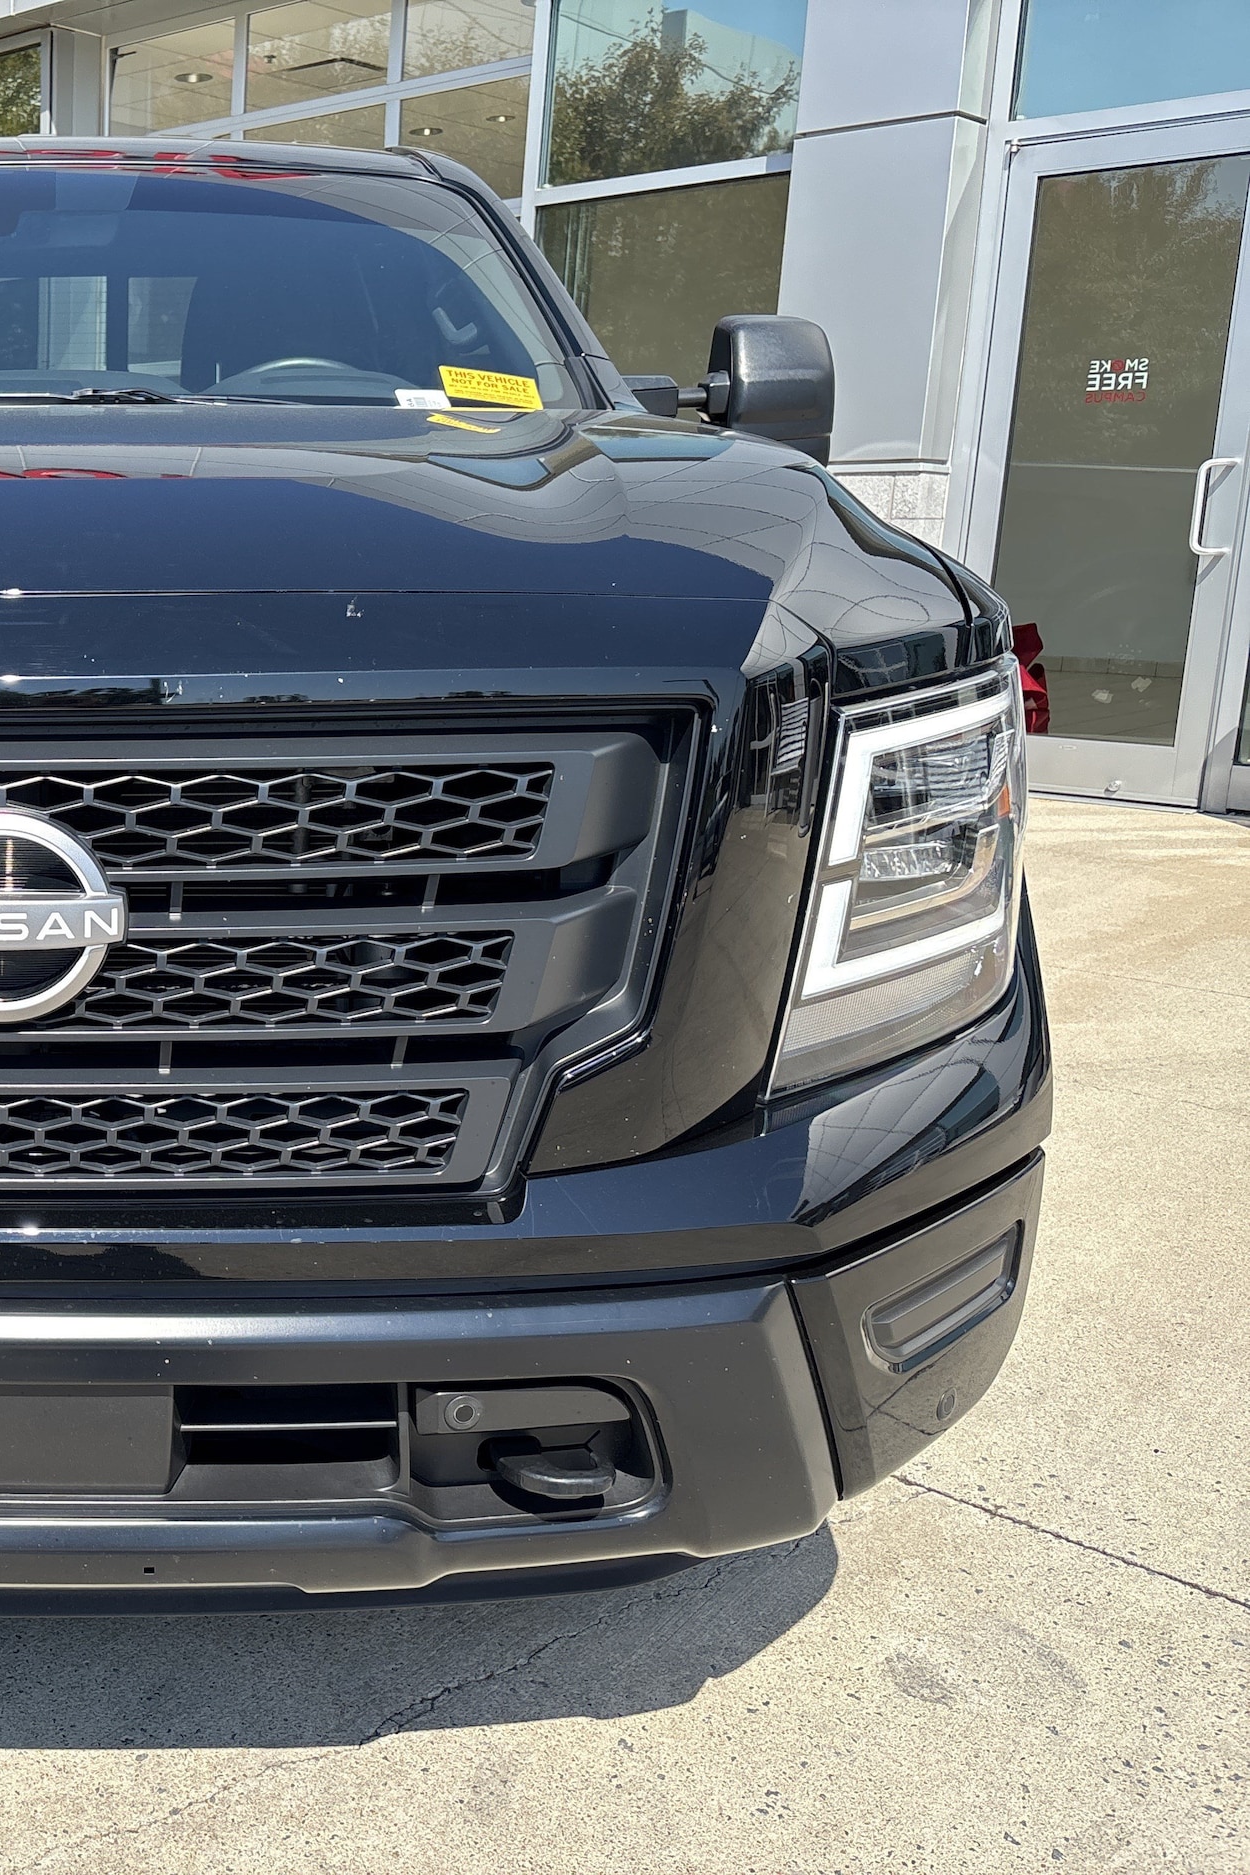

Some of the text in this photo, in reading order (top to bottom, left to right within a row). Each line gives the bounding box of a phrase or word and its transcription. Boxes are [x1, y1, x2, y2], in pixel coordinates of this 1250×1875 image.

[446, 369, 530, 388] THIS VEHICLE
[451, 378, 472, 386] NOT
[477, 381, 499, 389] FOR
[502, 384, 530, 394] SALE
